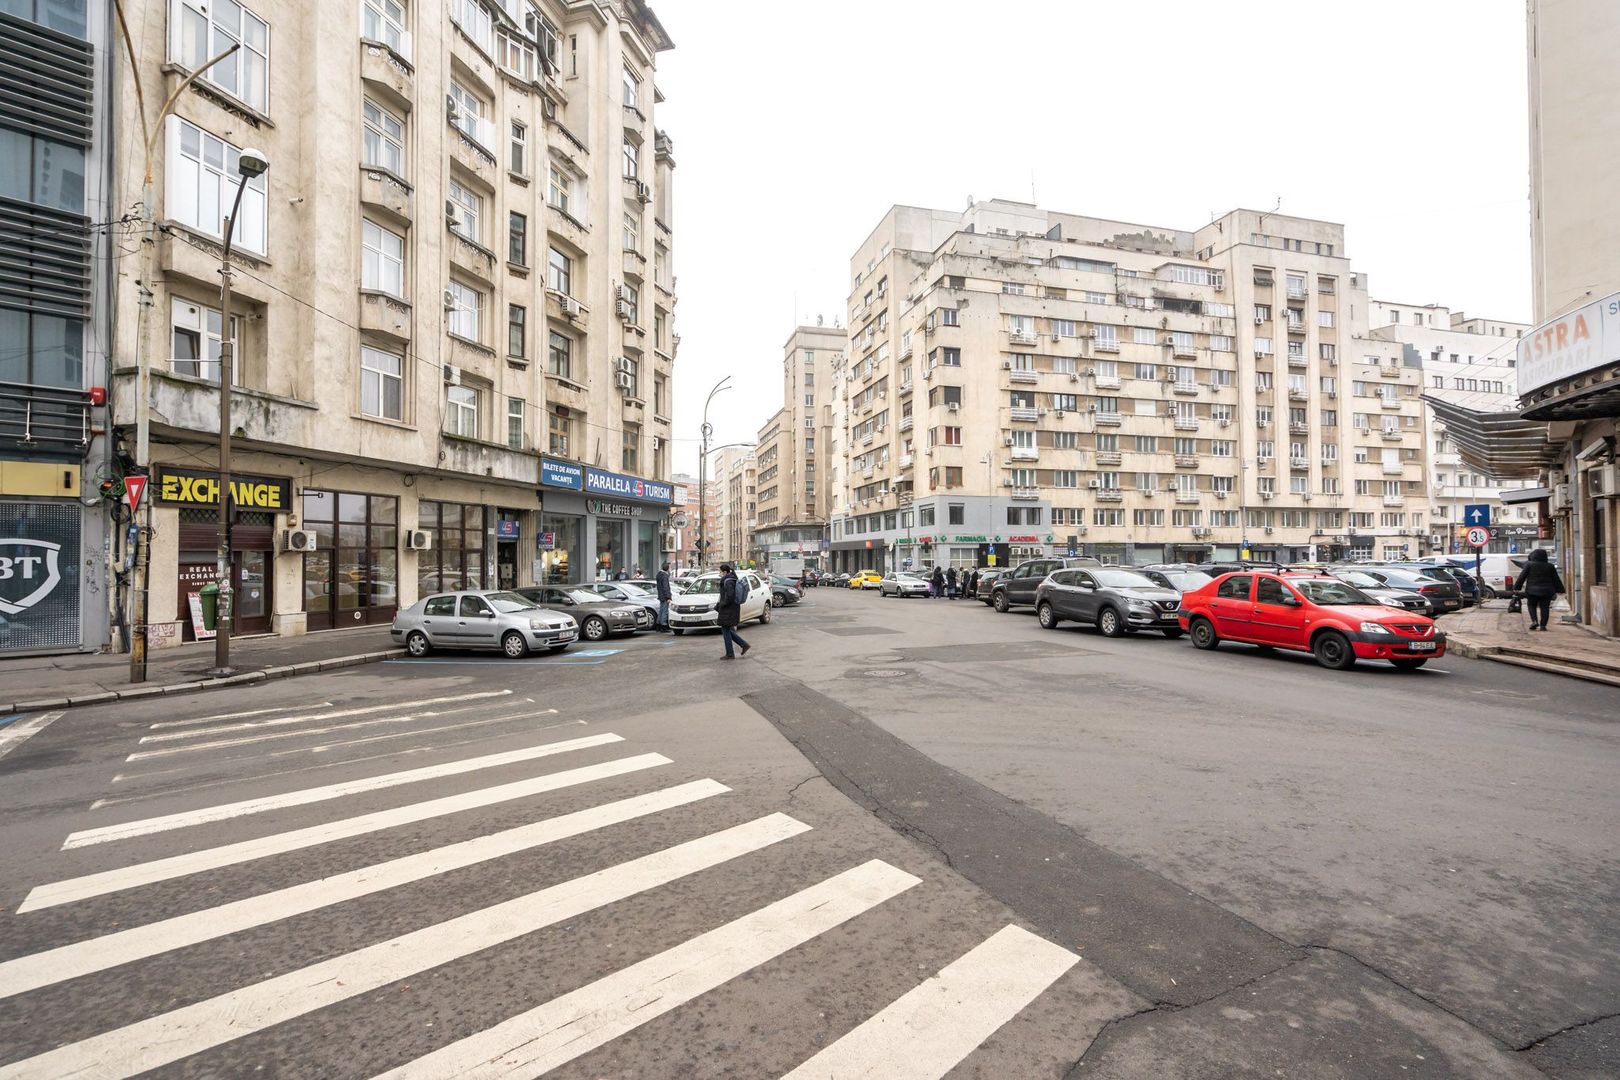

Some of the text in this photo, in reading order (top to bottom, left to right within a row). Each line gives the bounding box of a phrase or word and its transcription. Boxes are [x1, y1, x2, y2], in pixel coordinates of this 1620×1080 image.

[1523, 313, 1591, 362] ASTRA
[543, 462, 559, 472] BILETE
[566, 467, 580, 476] AVION
[588, 473, 631, 493] PARALELA
[644, 484, 670, 499] TURISM
[601, 503, 642, 517] THE COFFEE SHOP
[955, 535, 1040, 543] FARMACIA ACADEMIA
[0, 556, 42, 579] BT
[179, 572, 220, 580] EXCHANG
